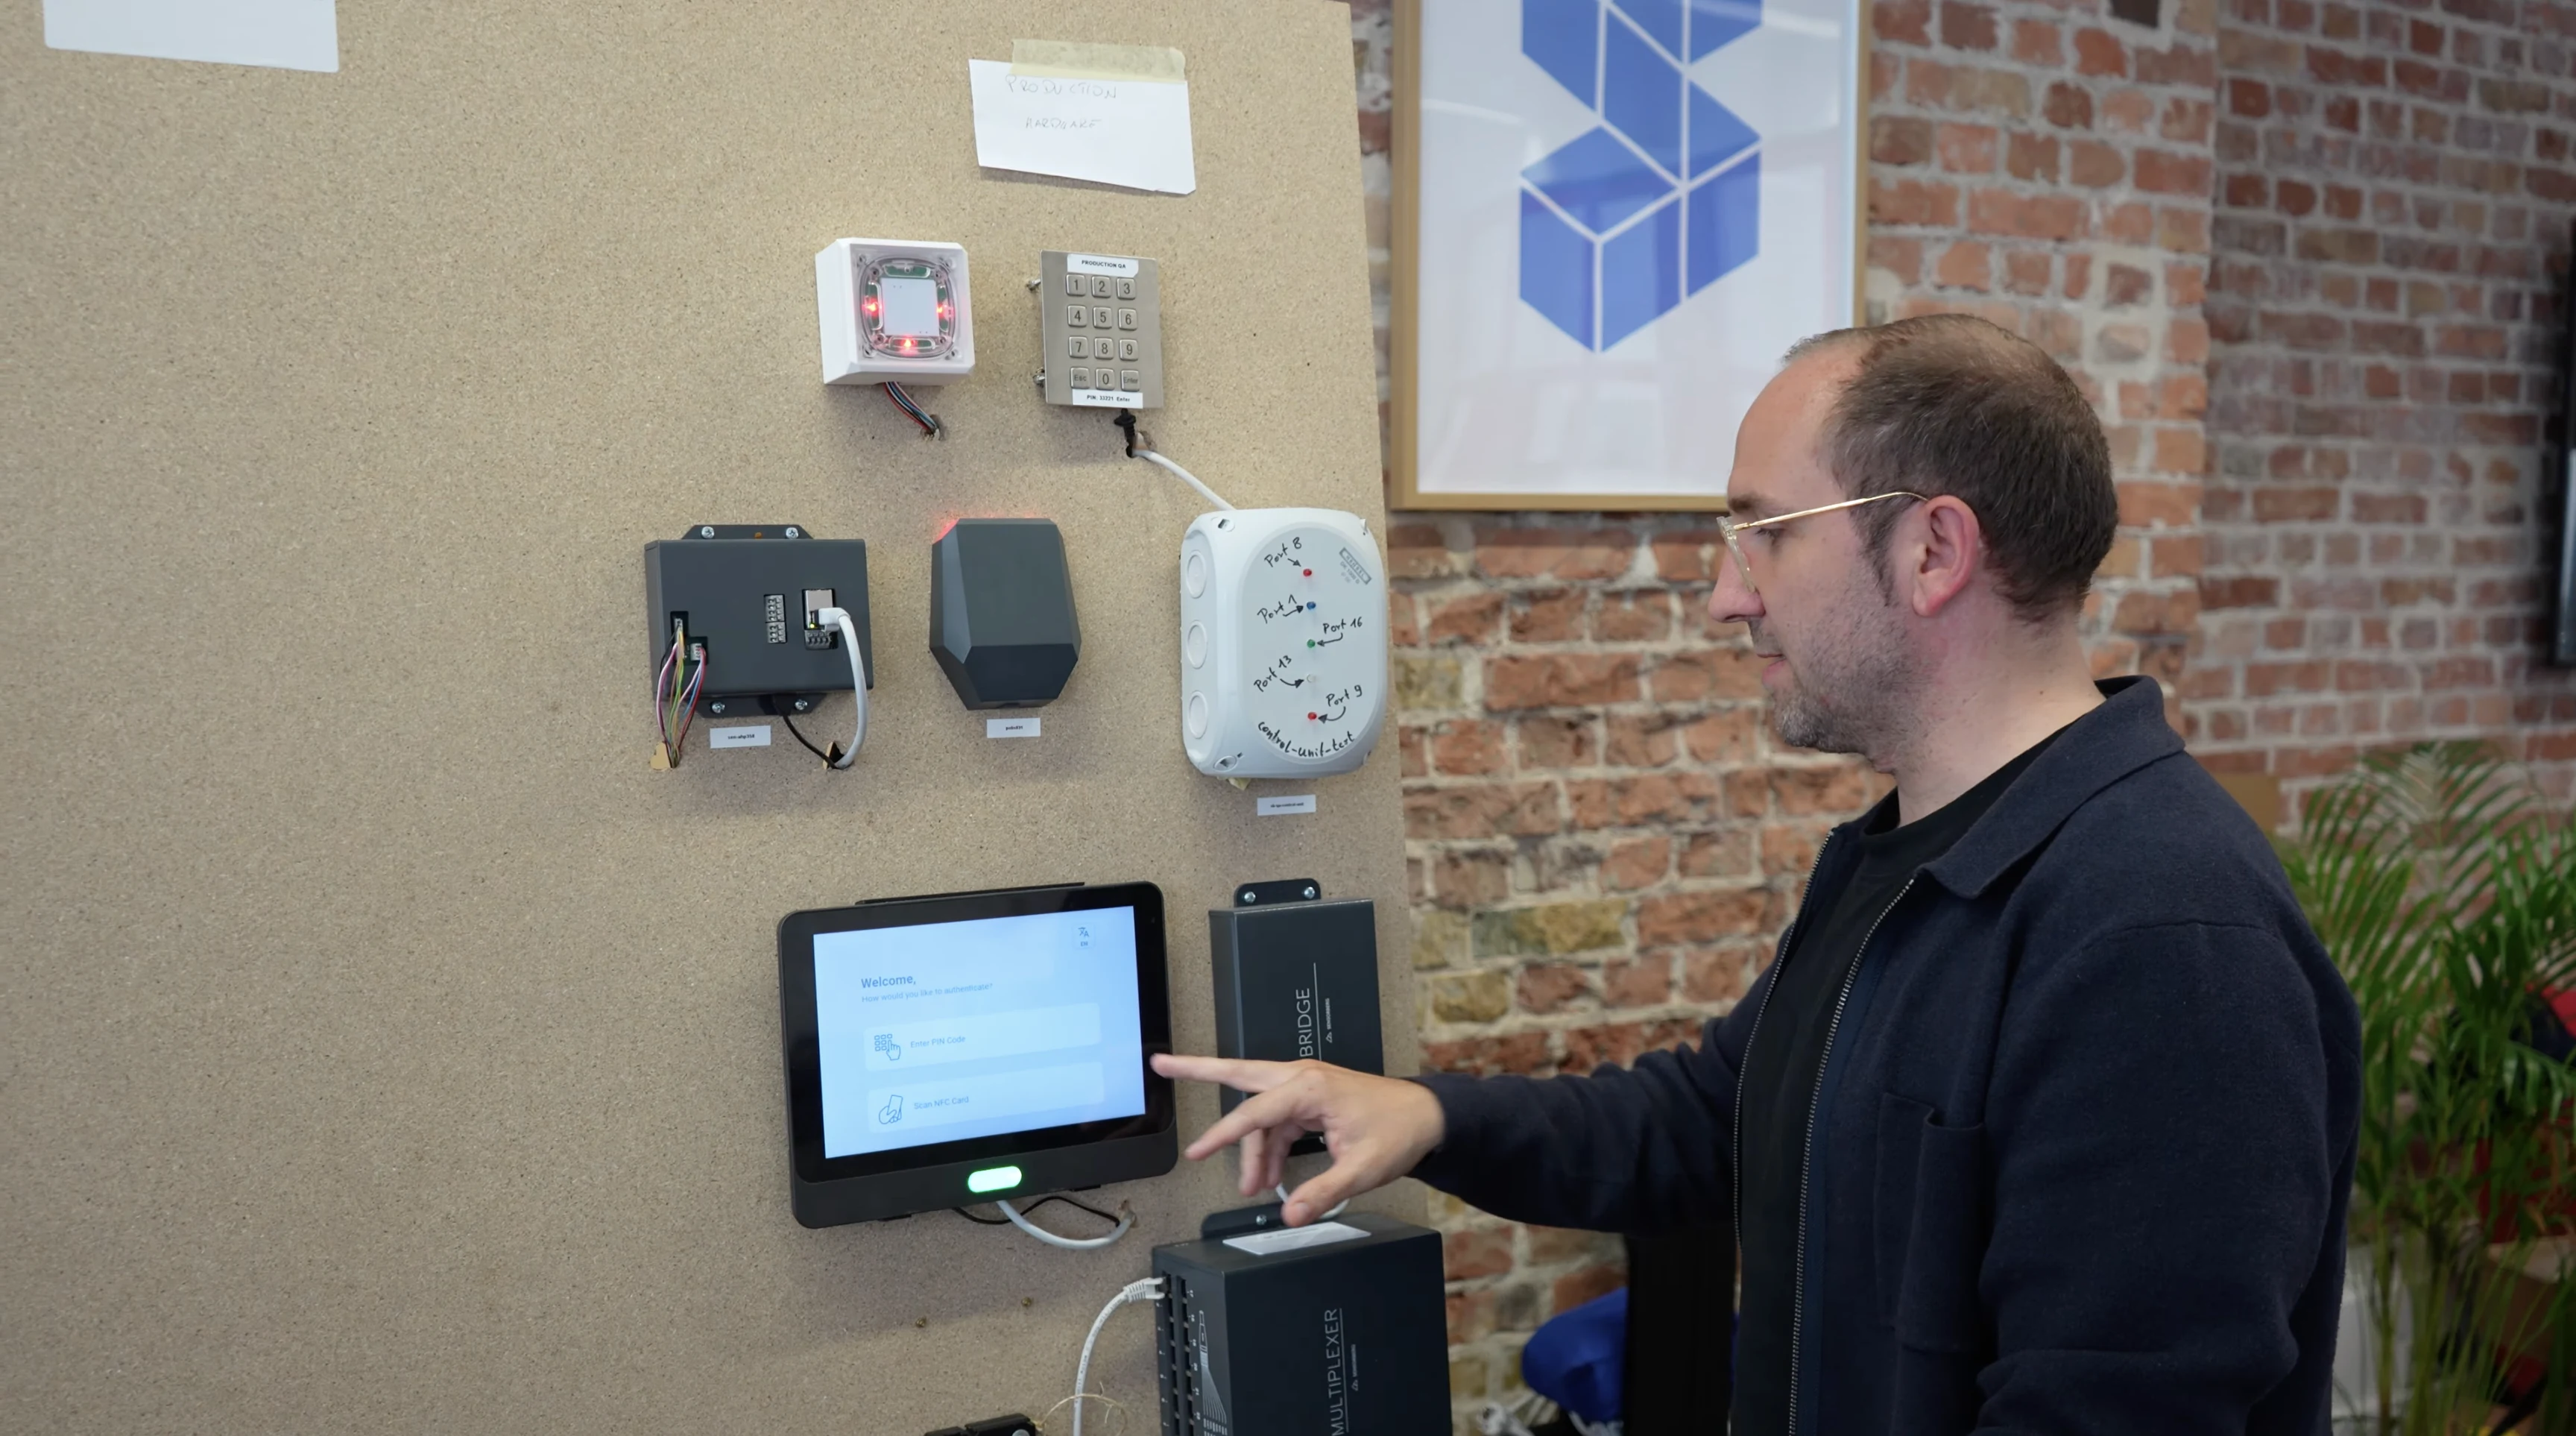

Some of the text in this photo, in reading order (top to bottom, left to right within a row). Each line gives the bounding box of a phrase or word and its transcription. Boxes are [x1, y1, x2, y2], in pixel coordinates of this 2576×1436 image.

[1006, 74, 1117, 99] PRODUCTION
[1074, 280, 1130, 295] 1 2 3
[1074, 310, 1131, 325] 4 5 6
[1076, 341, 1133, 355] 7 8 9
[1102, 374, 1109, 385] 0
[1264, 537, 1302, 567] Port 8
[1257, 594, 1297, 624] Port 1
[1322, 616, 1363, 634] Port 16
[1253, 655, 1292, 692] Port 13
[1326, 684, 1363, 707] Port 9
[861, 975, 916, 989] Welcome,
[881, 992, 903, 1001] would
[905, 992, 918, 1000] you
[921, 989, 933, 997] like
[944, 983, 993, 995] authenticate?
[1295, 987, 1314, 1057] BRIDGE
[910, 1036, 966, 1048] Enter PIN Code
[914, 1095, 969, 1109] Scan NFC Card
[1324, 1308, 1345, 1436] MULTIPLEXER
